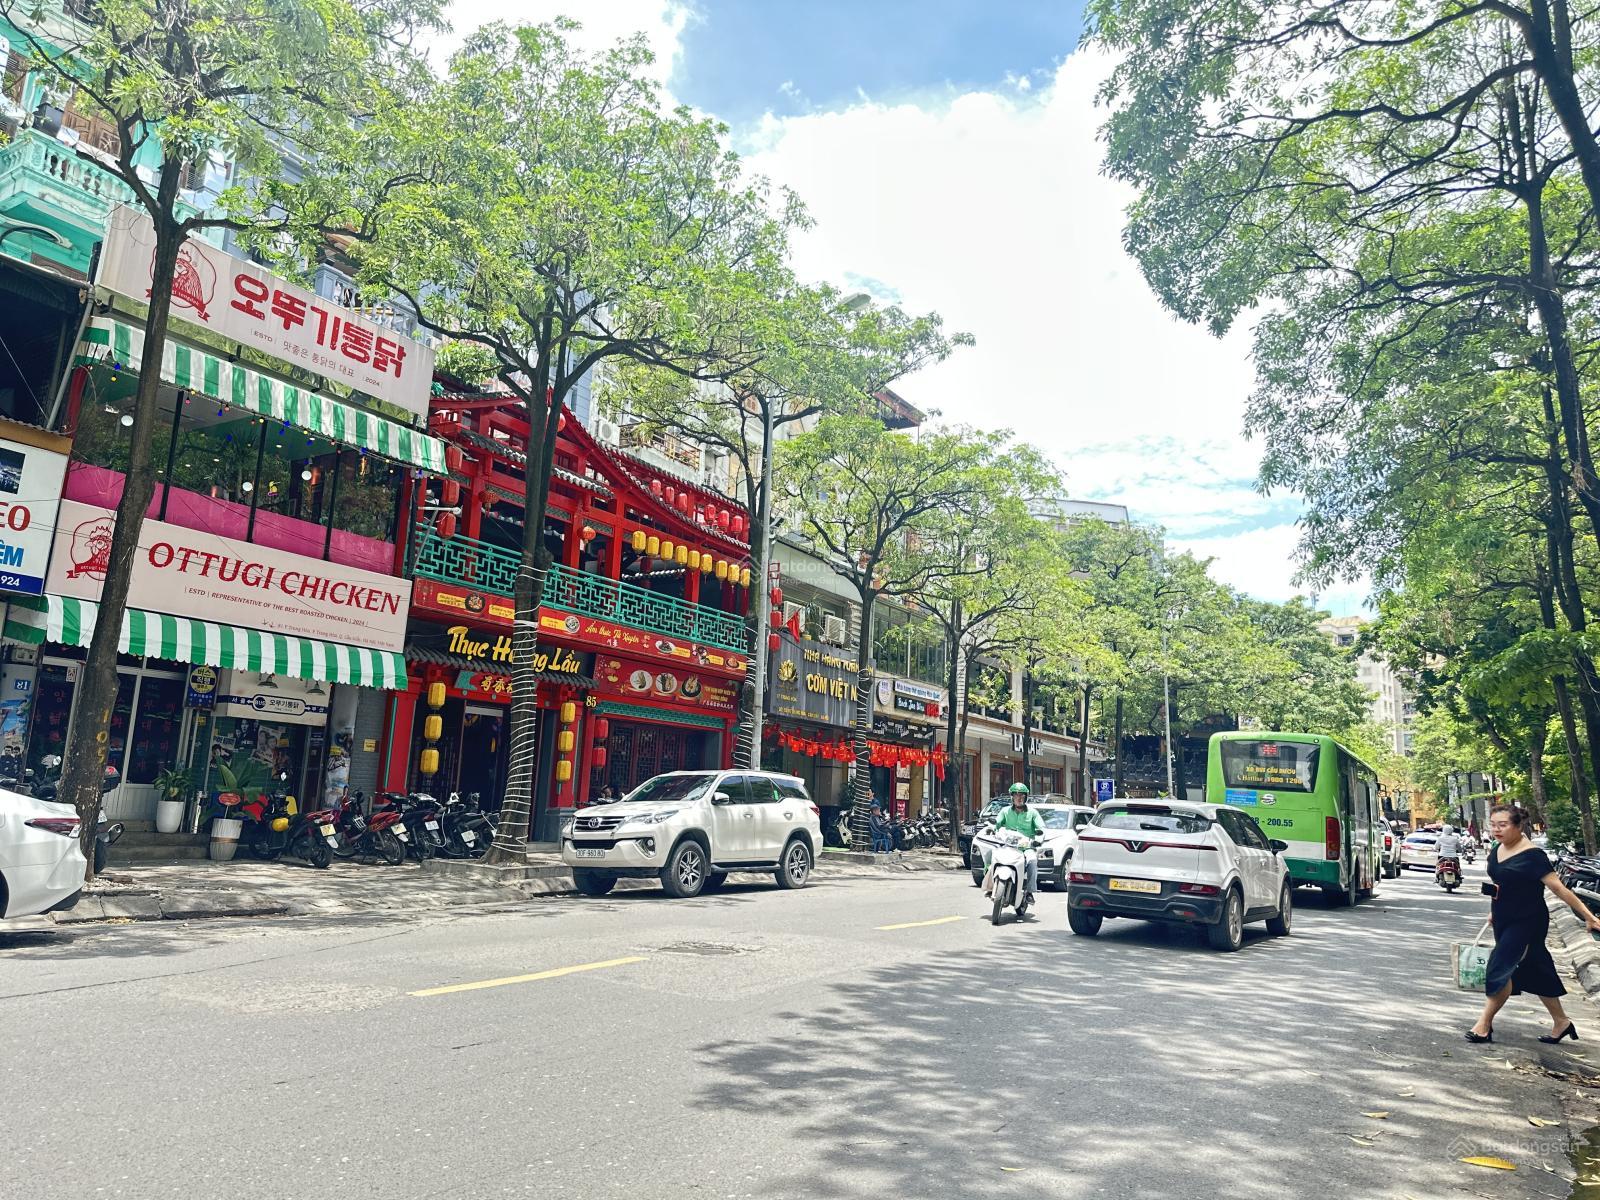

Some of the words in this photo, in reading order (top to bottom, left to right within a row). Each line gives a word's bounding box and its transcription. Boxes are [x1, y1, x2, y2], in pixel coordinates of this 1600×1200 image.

[231, 273, 407, 378] 오뚜기통닭
[148, 541, 276, 590] OTTUGI
[280, 570, 402, 615] CHICKEN
[188, 587, 206, 596] ESTD
[211, 592, 262, 607] REPRESENTATIVE
[272, 603, 284, 611] THE
[299, 609, 325, 618] ROASTED
[325, 613, 349, 623] CHICKEN
[447, 625, 489, 661] Thục
[586, 695, 597, 708] 85
